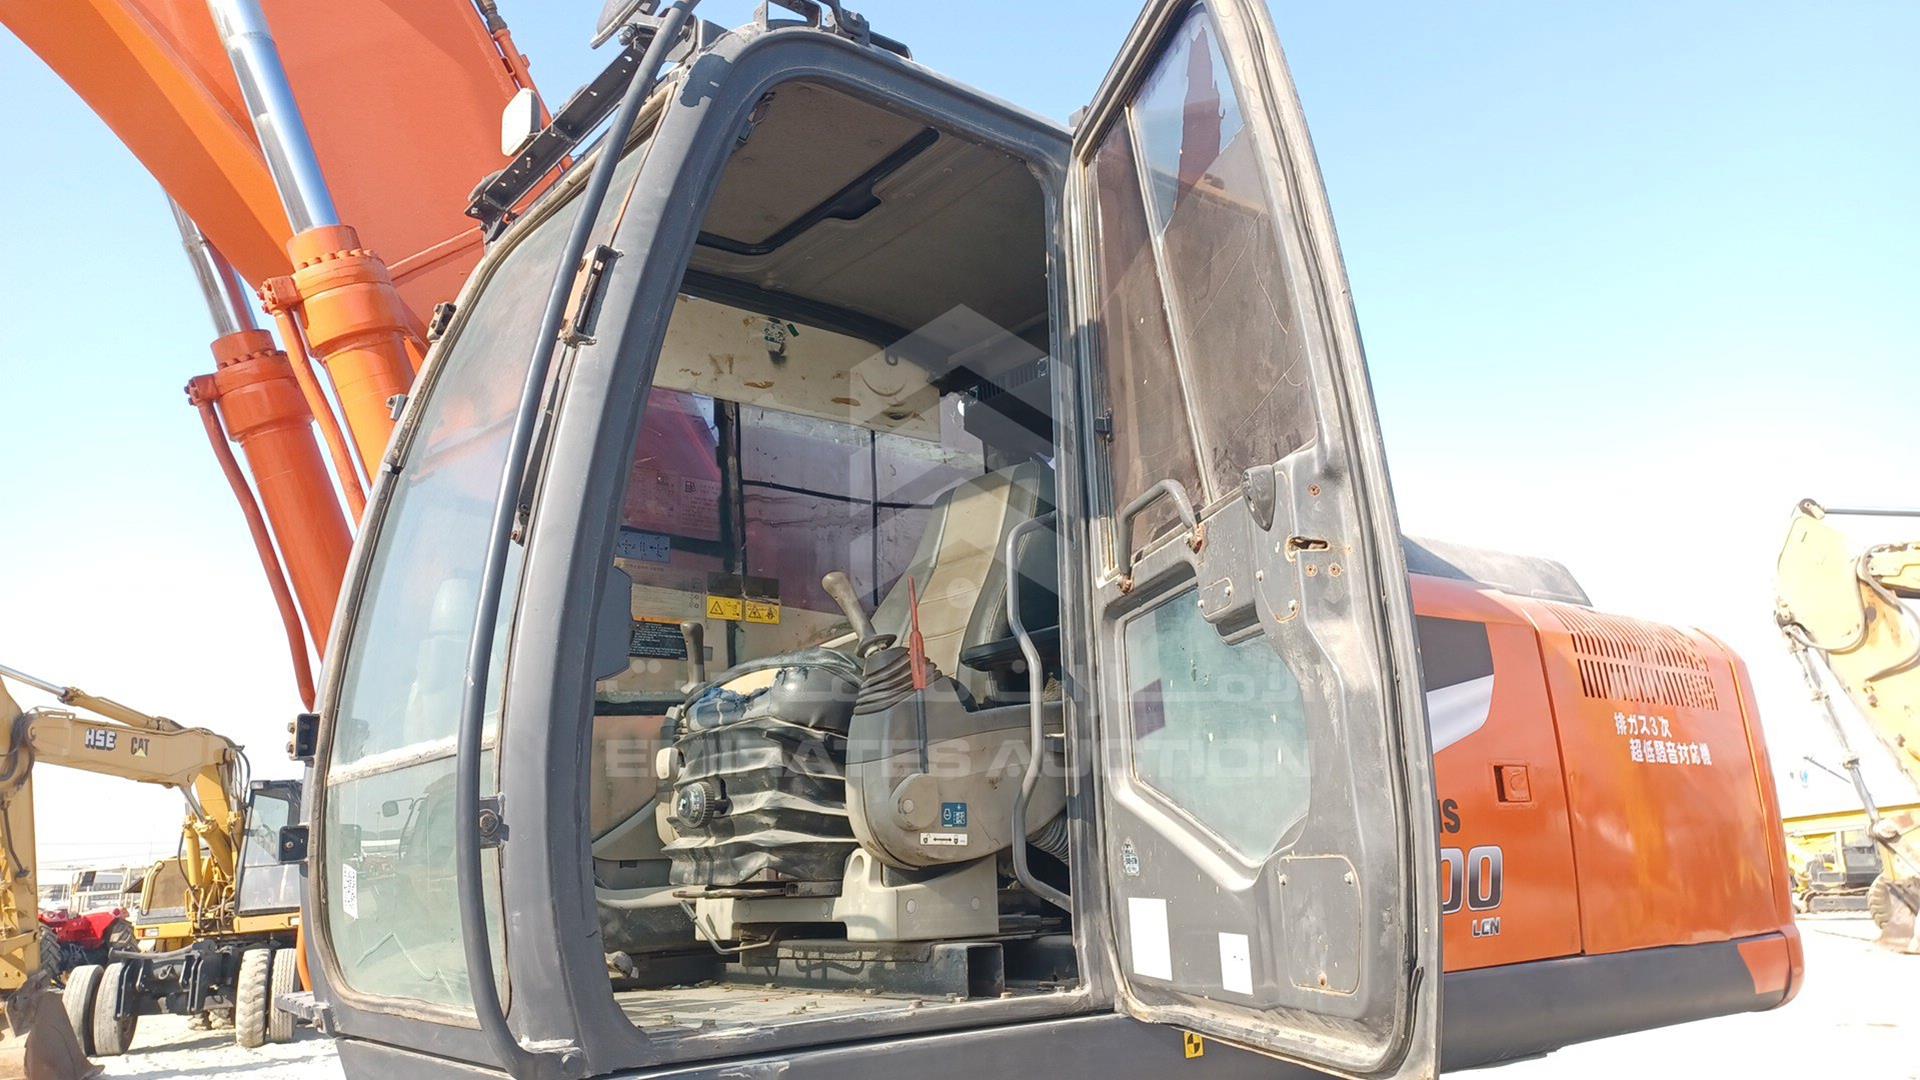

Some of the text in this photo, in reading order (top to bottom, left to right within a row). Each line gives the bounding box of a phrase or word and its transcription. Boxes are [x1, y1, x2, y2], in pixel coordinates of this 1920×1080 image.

[85, 729, 117, 751] HSE
[130, 736, 151, 758] CAT
[1472, 917, 1501, 938] LCN
